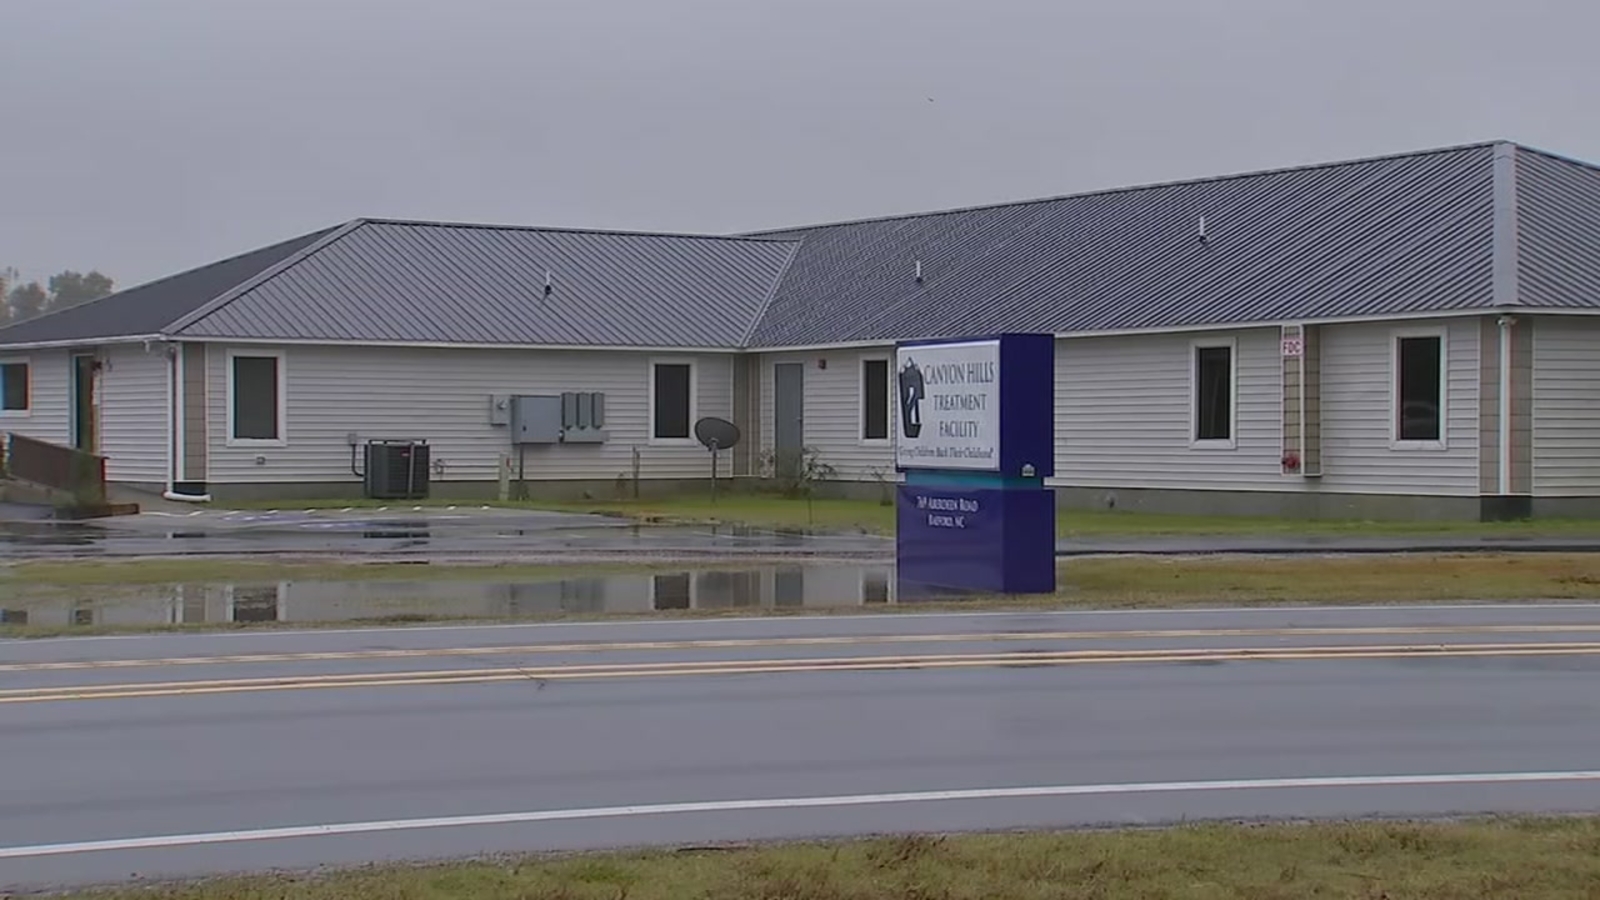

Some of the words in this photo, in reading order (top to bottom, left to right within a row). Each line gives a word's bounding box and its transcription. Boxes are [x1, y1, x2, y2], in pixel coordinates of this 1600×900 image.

[1283, 341, 1301, 354] FDC
[925, 364, 965, 385] CANYON
[966, 361, 994, 383] HILLS
[933, 393, 987, 411] TREATMENT
[939, 420, 978, 438] FACILITY
